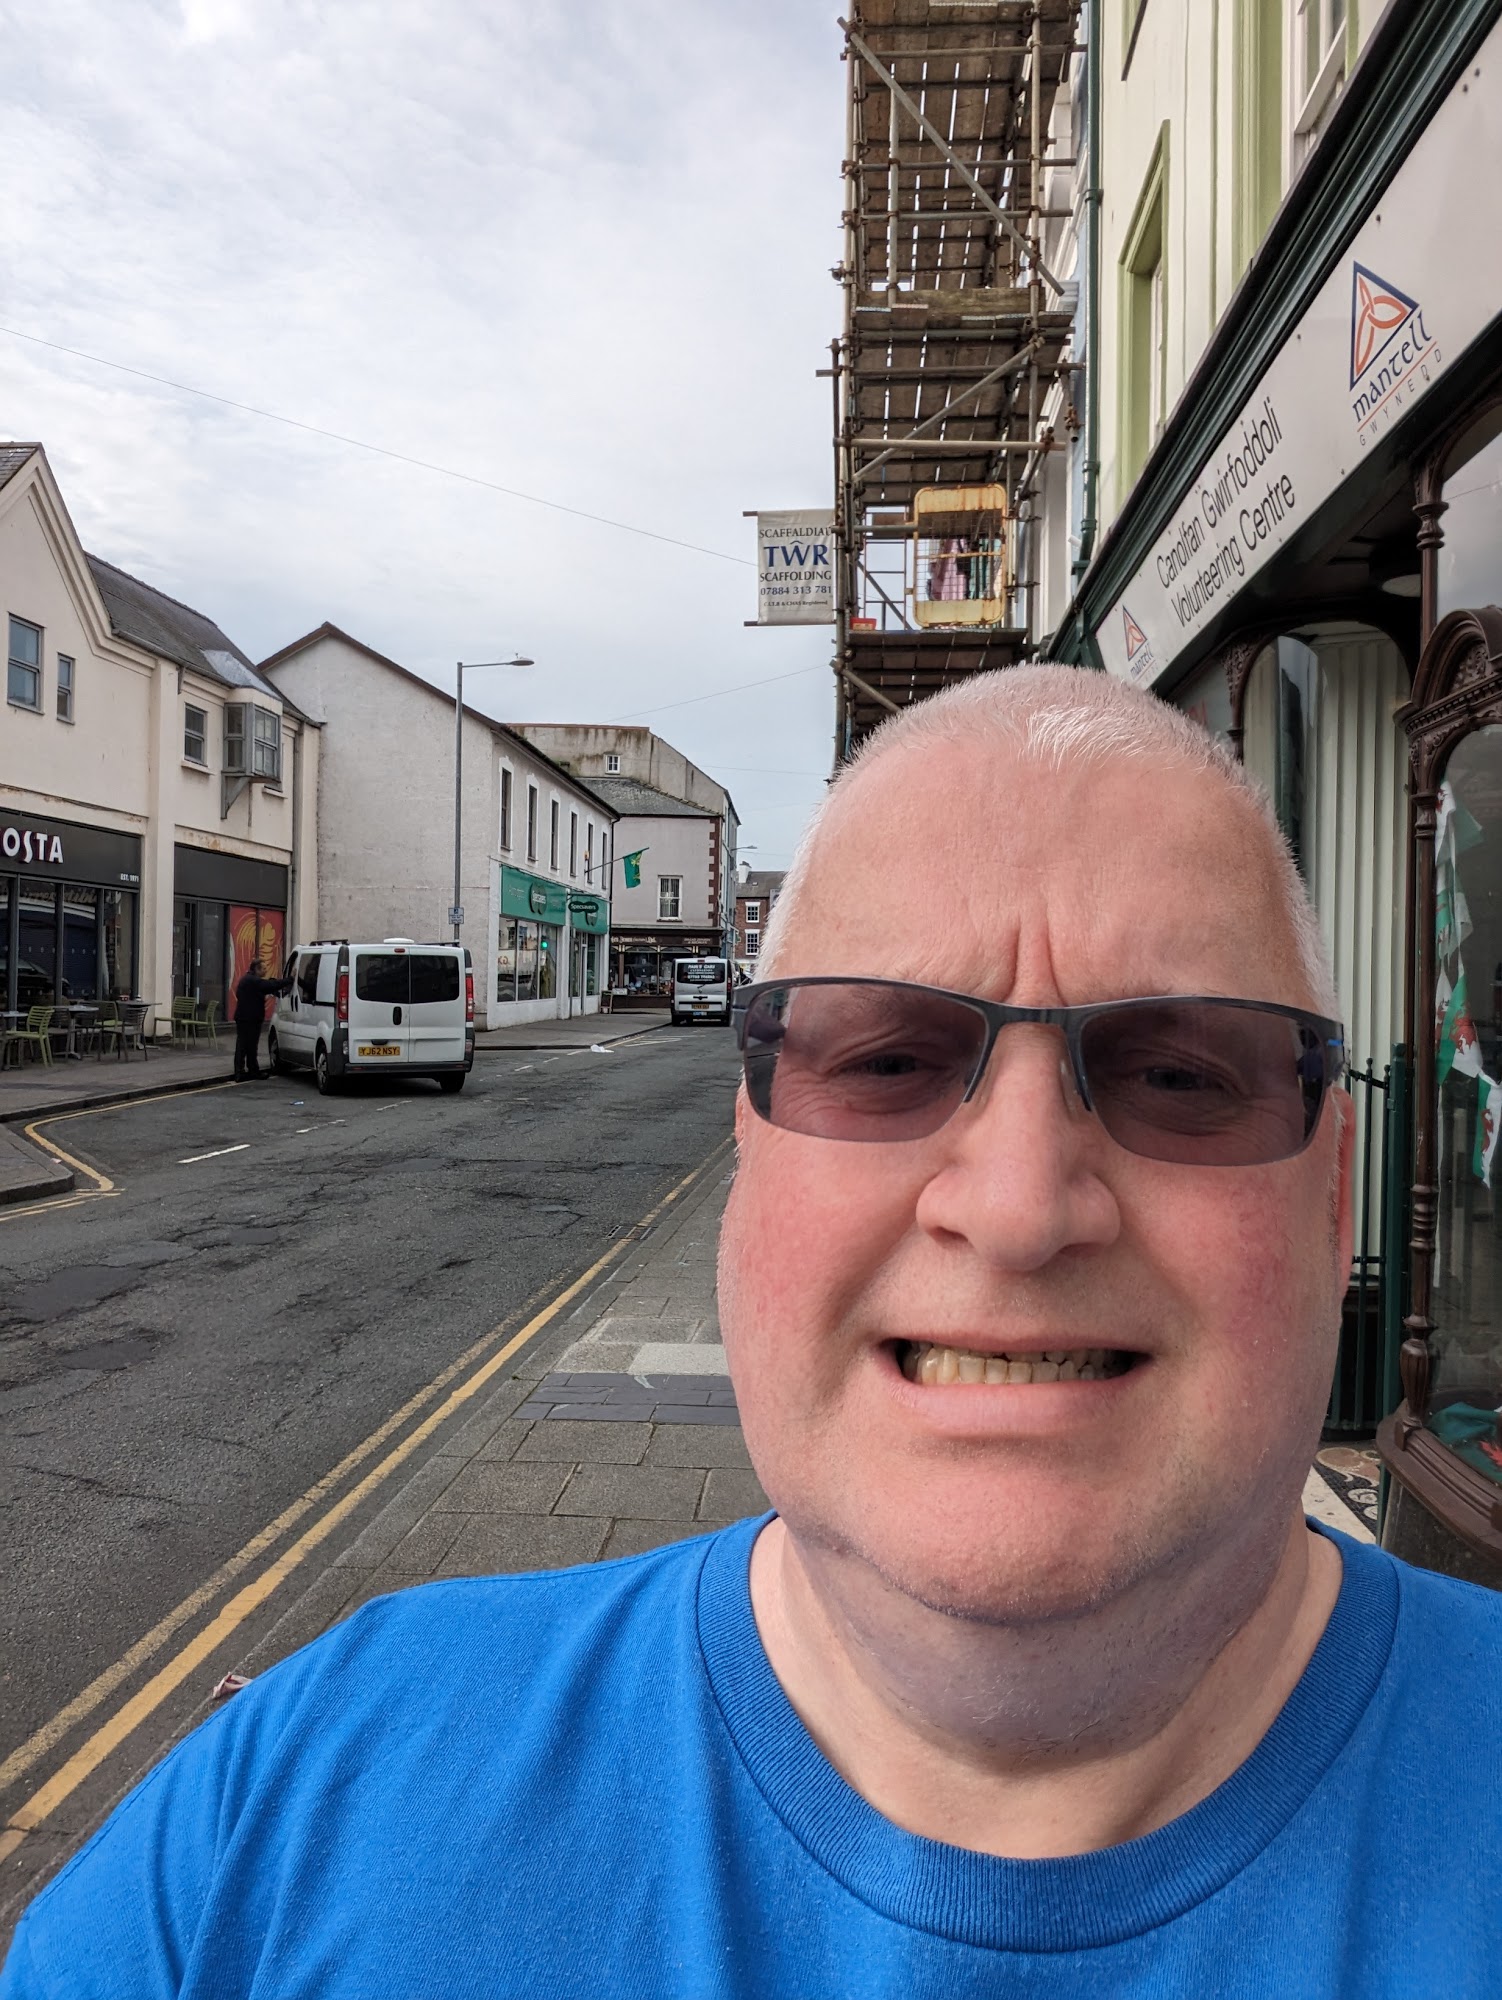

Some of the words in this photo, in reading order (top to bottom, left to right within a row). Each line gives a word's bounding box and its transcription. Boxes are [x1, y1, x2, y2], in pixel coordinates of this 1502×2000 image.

[1352, 309, 1432, 422] mantell
[1359, 348, 1442, 446] GWYNEDD
[1156, 516, 1206, 588] Canolfan
[1201, 397, 1282, 528] Gwirfoddoli
[760, 570, 832, 582] SCAFFOLDING
[1171, 535, 1245, 627] Volunteering
[1239, 474, 1295, 551] Centre
[760, 586, 790, 595] 07884
[793, 586, 811, 595] 313
[815, 585, 832, 594] 781
[2, 827, 64, 864] OSTA
[361, 1047, 381, 1055] YJ62
[382, 1046, 397, 1055] NSY
